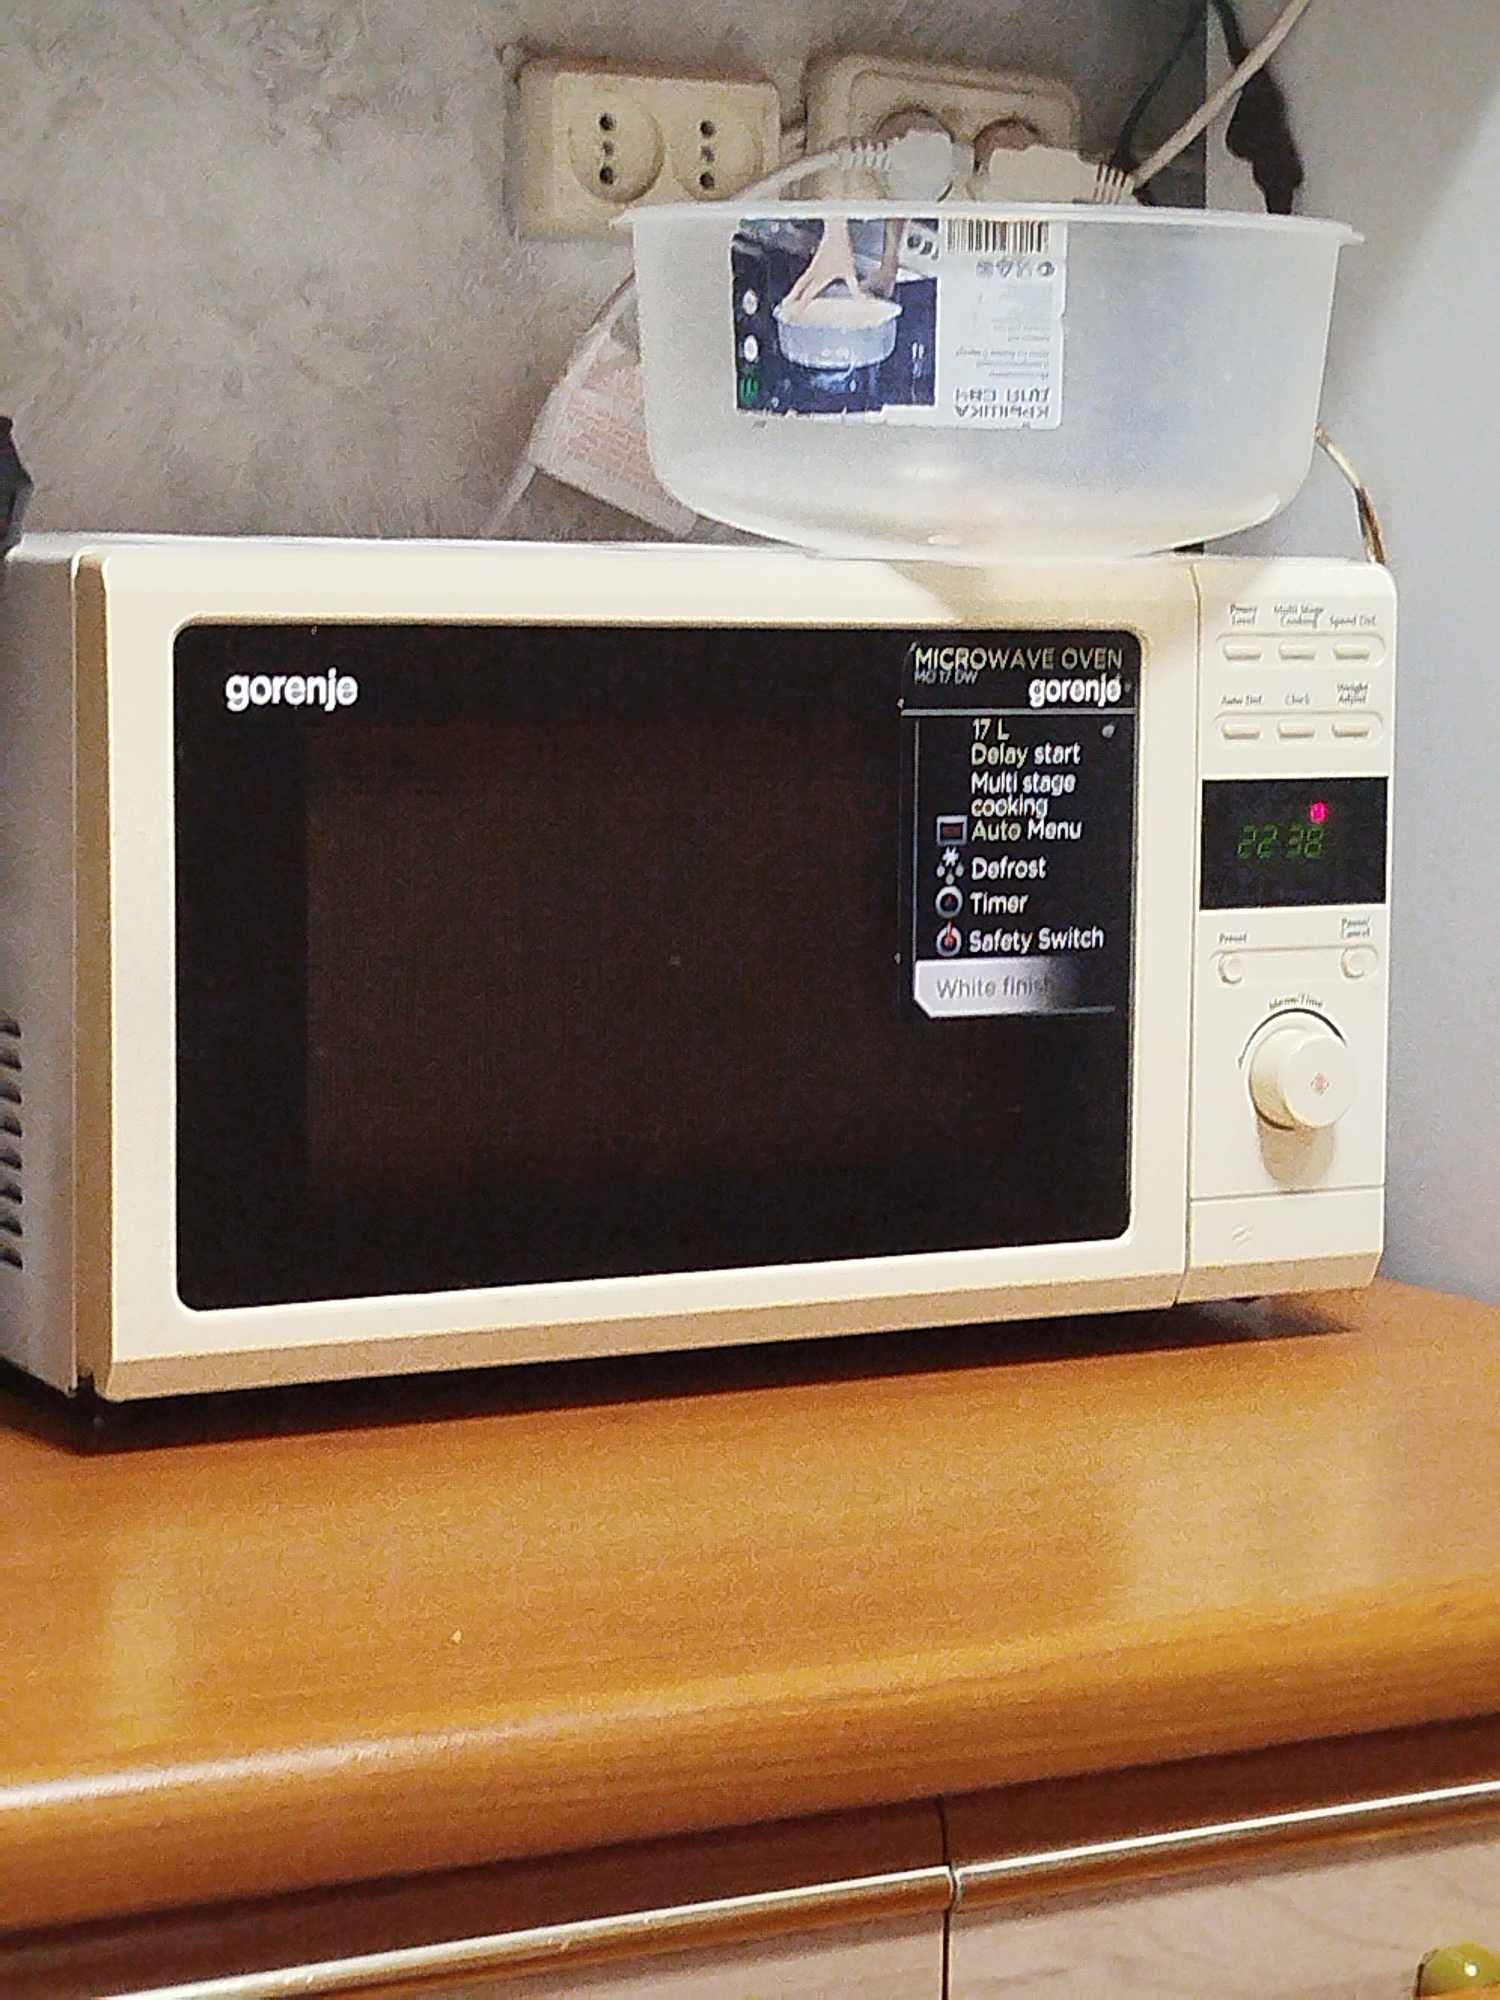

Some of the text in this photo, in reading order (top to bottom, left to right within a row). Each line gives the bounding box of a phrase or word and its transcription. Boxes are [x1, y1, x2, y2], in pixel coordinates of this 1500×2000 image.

[955, 405, 1049, 419] КРЫШКА
[915, 648, 1123, 670] MICROWAVE OVEN
[225, 667, 358, 712] gorenje
[1028, 673, 1122, 708] gorenje
[973, 717, 1010, 740] 17 L
[971, 741, 1081, 768] Delay start
[971, 770, 1077, 796] Multi stage
[971, 793, 1048, 817] cooking
[971, 818, 1082, 841] Auto Menu
[971, 855, 1048, 880] Defrost
[969, 891, 1029, 915] Timer
[968, 925, 1105, 954] Safety Switch
[936, 976, 996, 999] White
